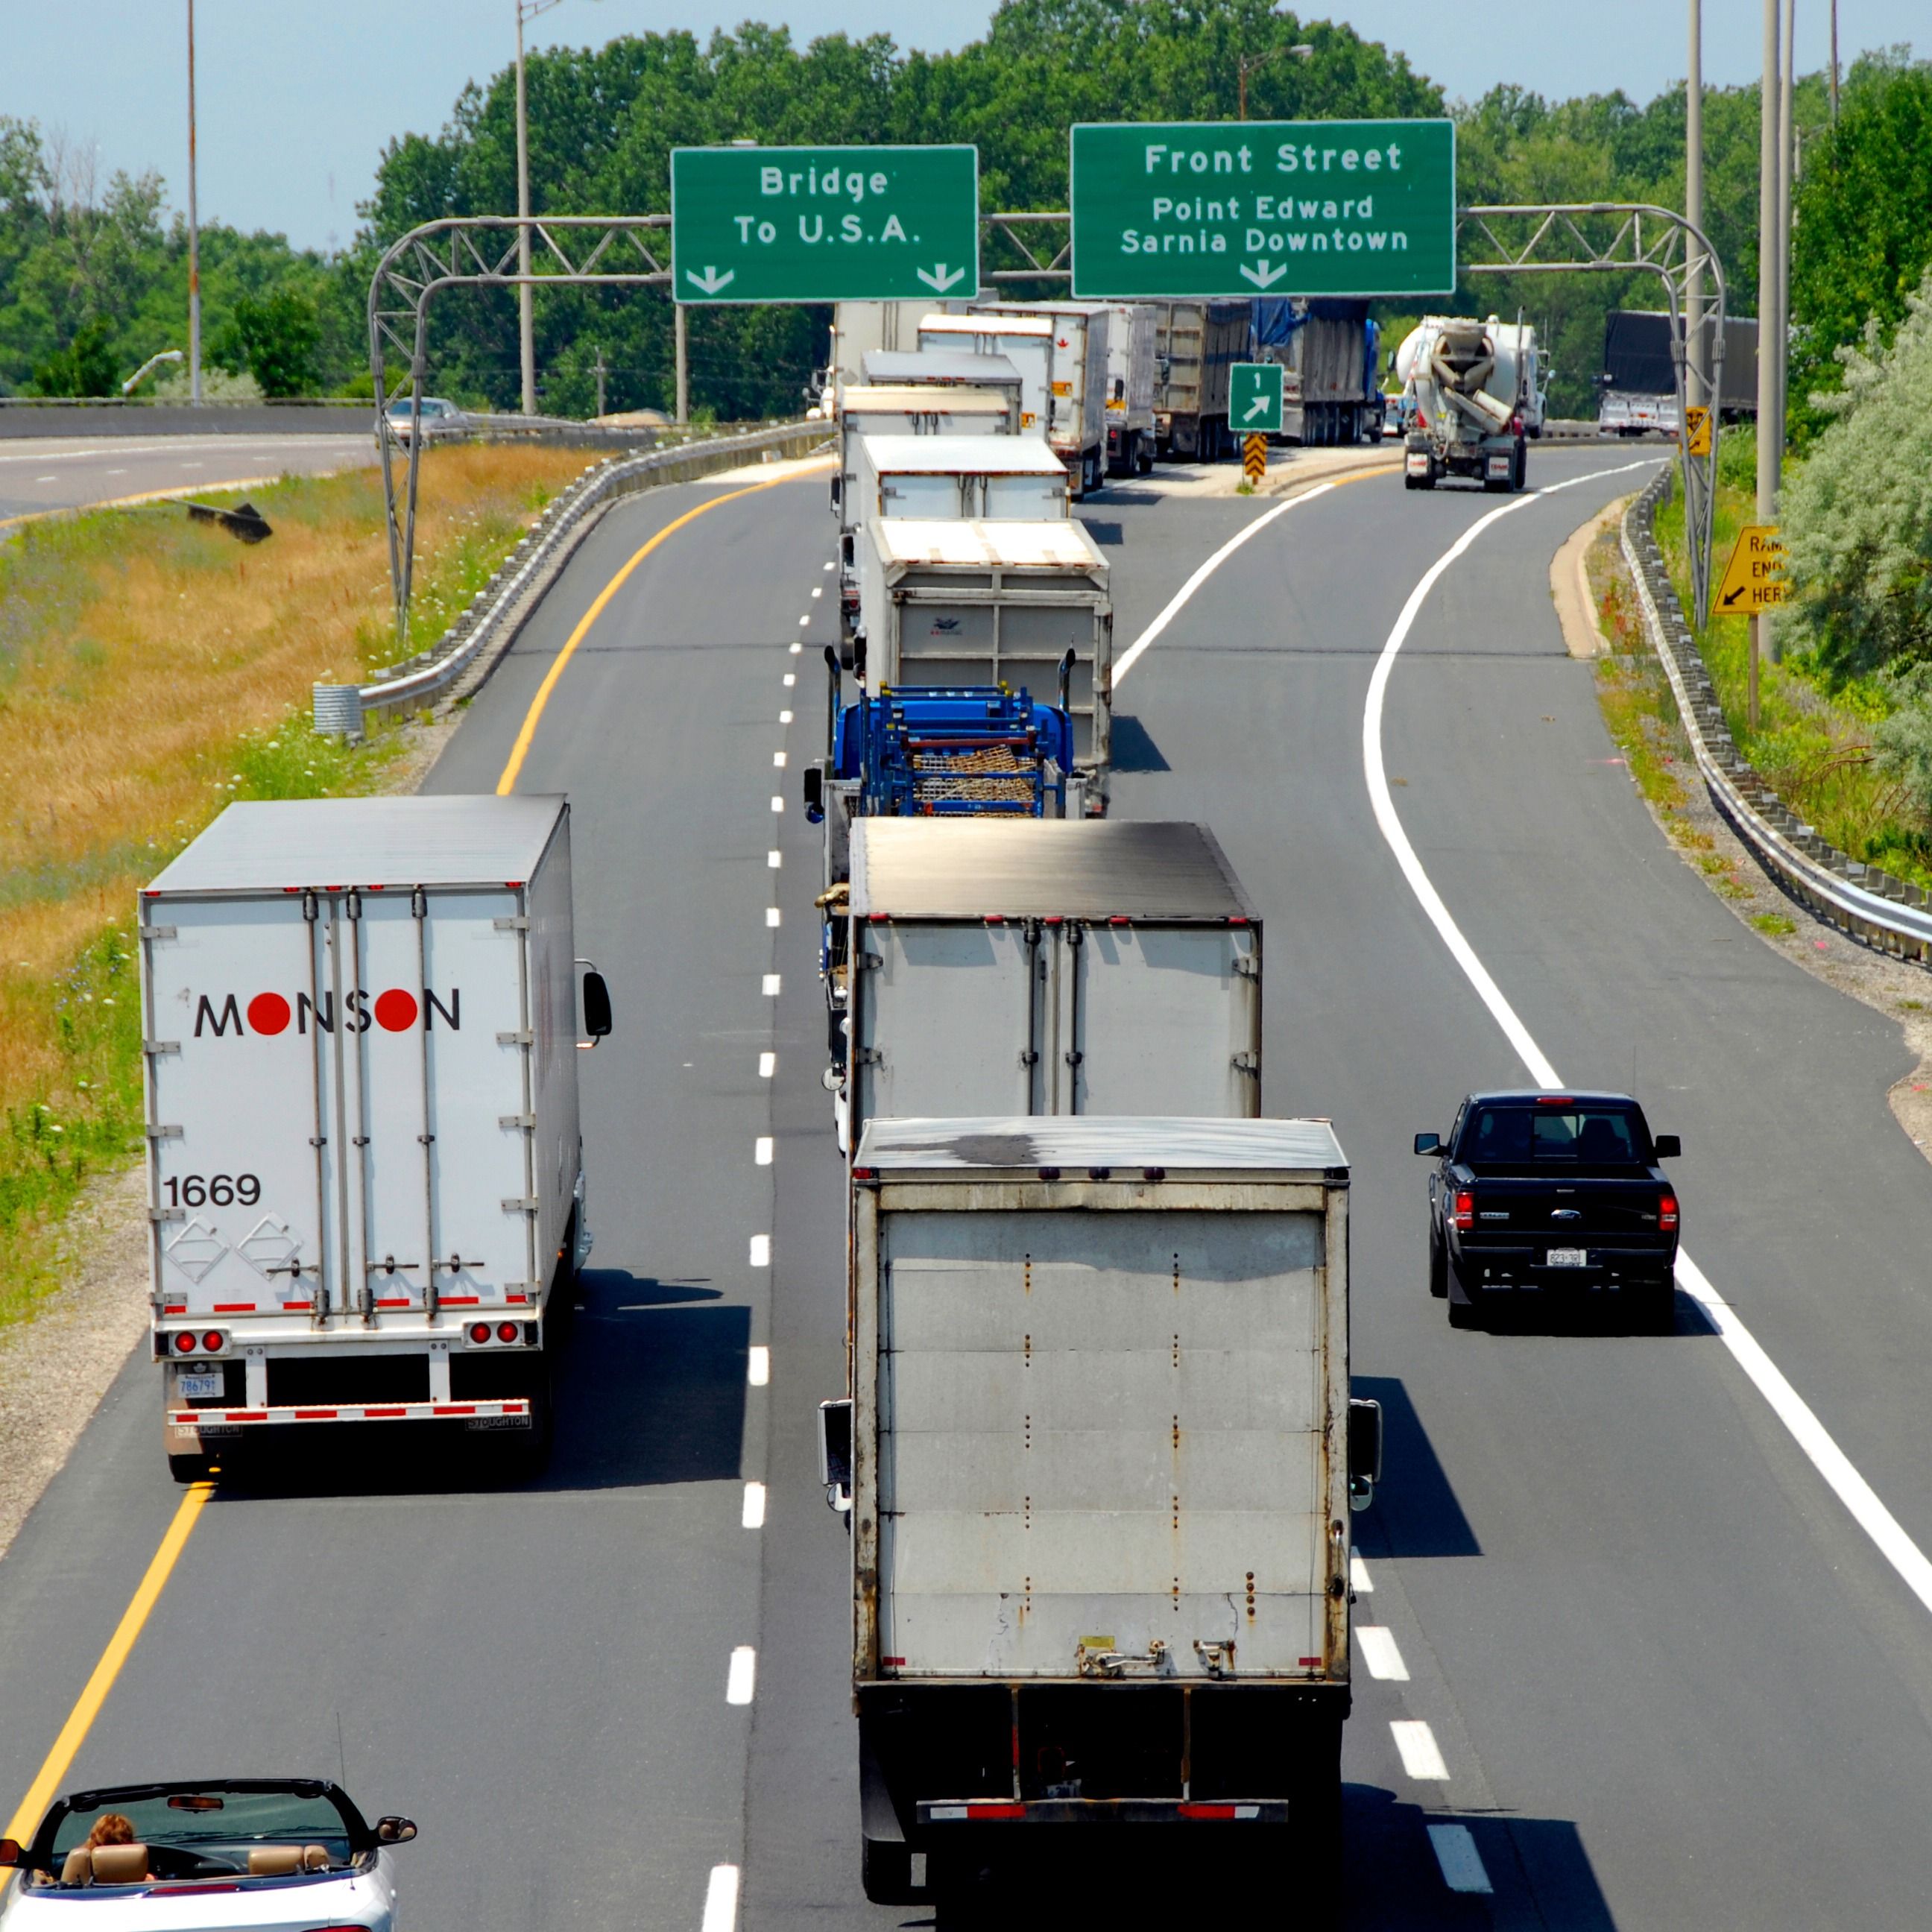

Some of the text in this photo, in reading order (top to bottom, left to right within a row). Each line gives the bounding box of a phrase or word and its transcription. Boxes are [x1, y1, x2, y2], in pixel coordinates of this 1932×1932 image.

[1146, 144, 1401, 172] Front Street
[760, 162, 888, 202] Bridge
[1153, 196, 1373, 220] Point Edward
[734, 215, 921, 244] To U.S.A.
[1122, 229, 1408, 253] Sarnia Downtown
[1254, 372, 1261, 390] 1
[1749, 536, 1787, 552] RAM
[1752, 587, 1787, 603] HER
[193, 988, 460, 1038] MONSON
[162, 1173, 261, 1208] 1669
[467, 1416, 529, 1428] STOUGHTON
